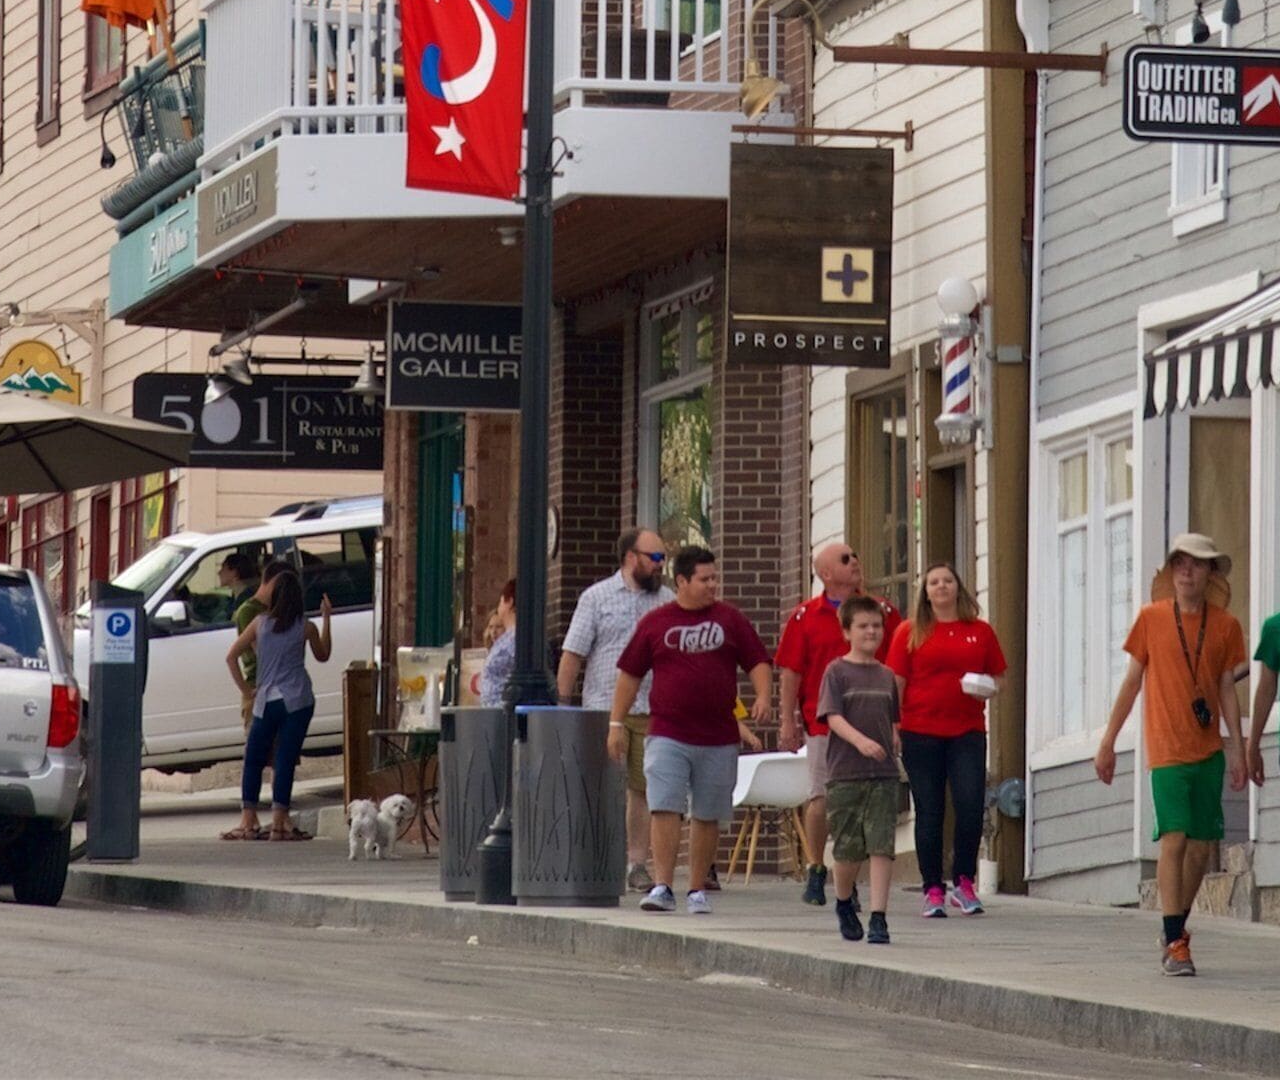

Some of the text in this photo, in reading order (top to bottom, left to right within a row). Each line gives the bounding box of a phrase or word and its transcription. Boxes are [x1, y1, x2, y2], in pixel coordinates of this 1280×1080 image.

[1137, 60, 1236, 94] OUTFITTER
[1138, 92, 1219, 125] TRADING
[393, 332, 523, 355] MCMILLE
[734, 332, 883, 351] PROSPECT
[399, 357, 520, 380] GALLER
[23, 658, 47, 669] PTL
